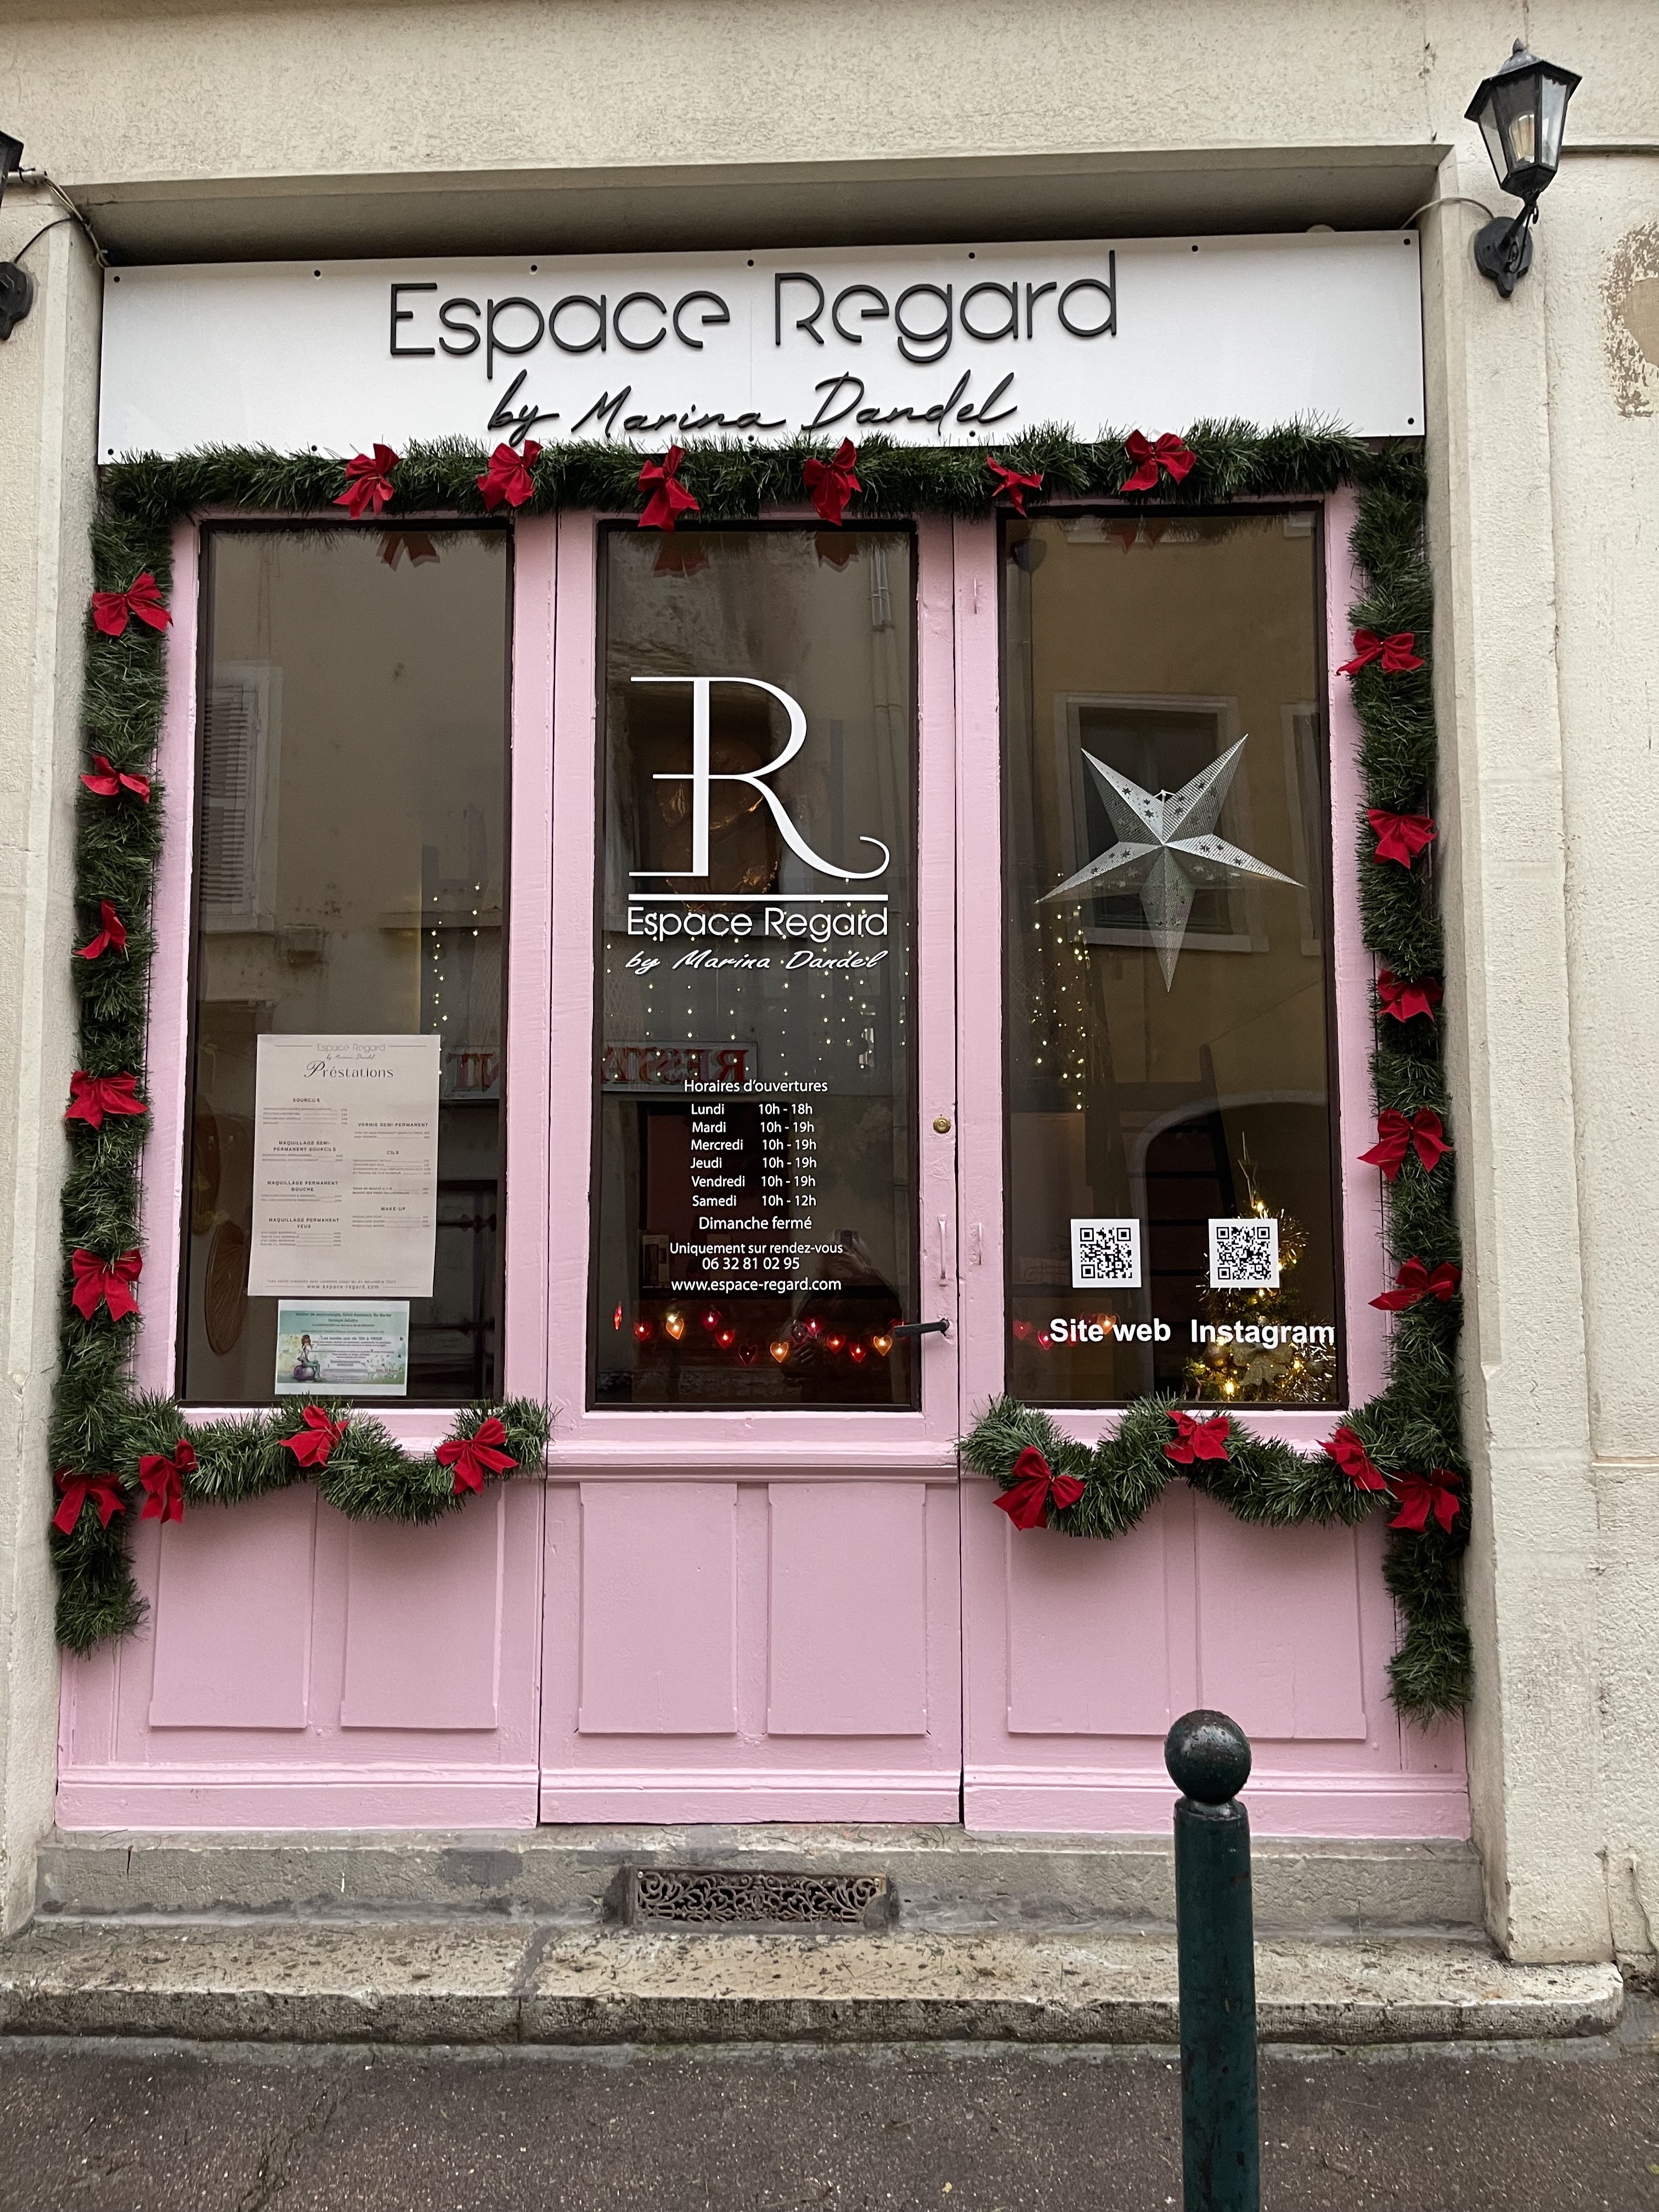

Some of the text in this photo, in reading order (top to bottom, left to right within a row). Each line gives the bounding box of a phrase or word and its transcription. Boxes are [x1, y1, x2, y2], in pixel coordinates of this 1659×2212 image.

[390, 249, 1118, 380] Espace Regard
[487, 369, 1017, 448] by Marina Dandel
[629, 676, 890, 879] R
[628, 906, 888, 943] Espace Regard
[625, 949, 889, 975] by Marina Dandel
[317, 1042, 386, 1054] Espace Regard
[304, 1060, 394, 1078] Préstations
[684, 1079, 828, 1092] Horaires d'ouvertures
[691, 1103, 725, 1115] Lundi
[759, 1103, 780, 1115] 10h
[791, 1103, 813, 1115] 18h
[692, 1121, 726, 1133] Mardi
[760, 1121, 782, 1133] 10h
[793, 1121, 815, 1133] 19h
[691, 1138, 743, 1150] Mercredi
[762, 1138, 783, 1150] 10h
[794, 1138, 816, 1150] 19h
[690, 1156, 722, 1169] Jeudi
[763, 1156, 784, 1169] 10h
[795, 1156, 817, 1169] 19h
[691, 1175, 745, 1187] Vendredi
[761, 1175, 783, 1187] 10h
[794, 1175, 816, 1187] 19h
[692, 1194, 737, 1206] Samedi
[762, 1194, 783, 1206] 10h
[795, 1194, 816, 1206] 12h
[699, 1216, 812, 1229] Dimanche fermé
[670, 1242, 843, 1256] Uniquement sur rendez-vous
[702, 1257, 800, 1270] 06 32 81 02 95
[671, 1277, 842, 1294] www.espace-regard.com
[1050, 1318, 1171, 1342] Site web
[1191, 1319, 1335, 1350] Instagram
